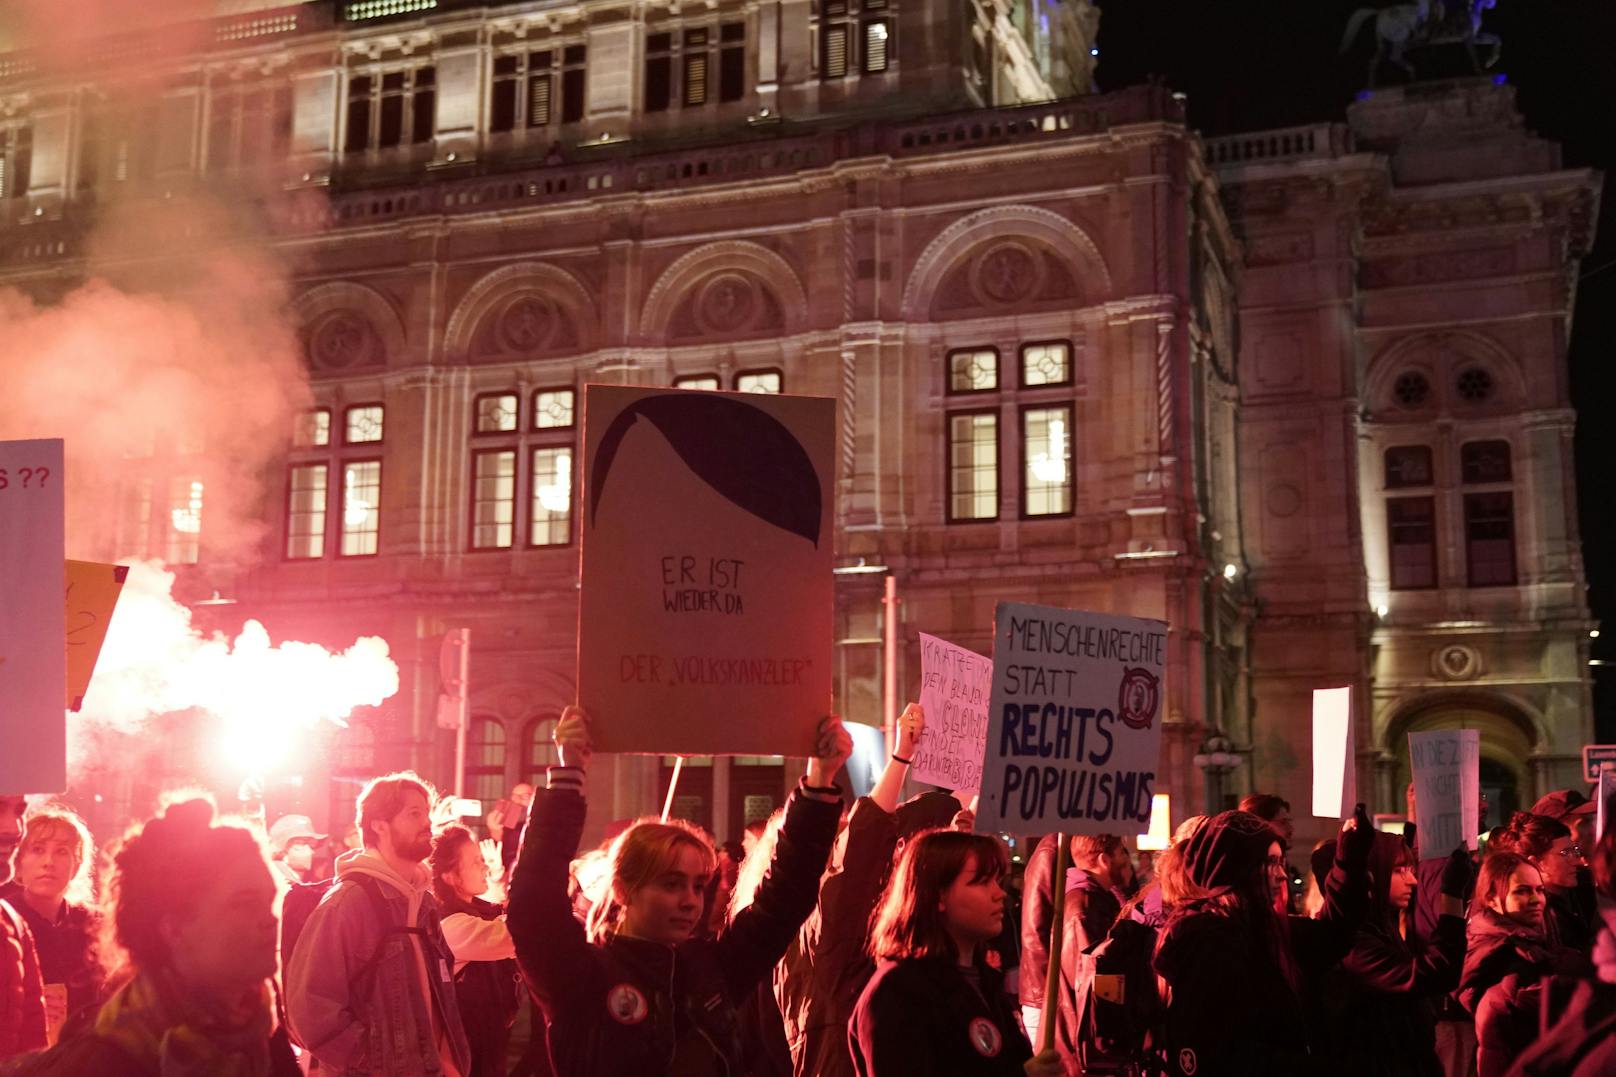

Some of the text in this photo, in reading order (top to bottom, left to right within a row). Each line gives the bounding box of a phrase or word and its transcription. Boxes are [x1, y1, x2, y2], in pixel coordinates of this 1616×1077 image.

[18, 466, 51, 488] ??
[661, 556, 745, 589] ER IST
[662, 589, 744, 615] WIEDER DA
[1008, 616, 1167, 666] MENSCHENRECHTE
[620, 654, 662, 684] DER
[1004, 664, 1077, 697] STATT
[1000, 702, 1115, 767] RECHTS
[1000, 764, 1156, 823] POPULISMUS
